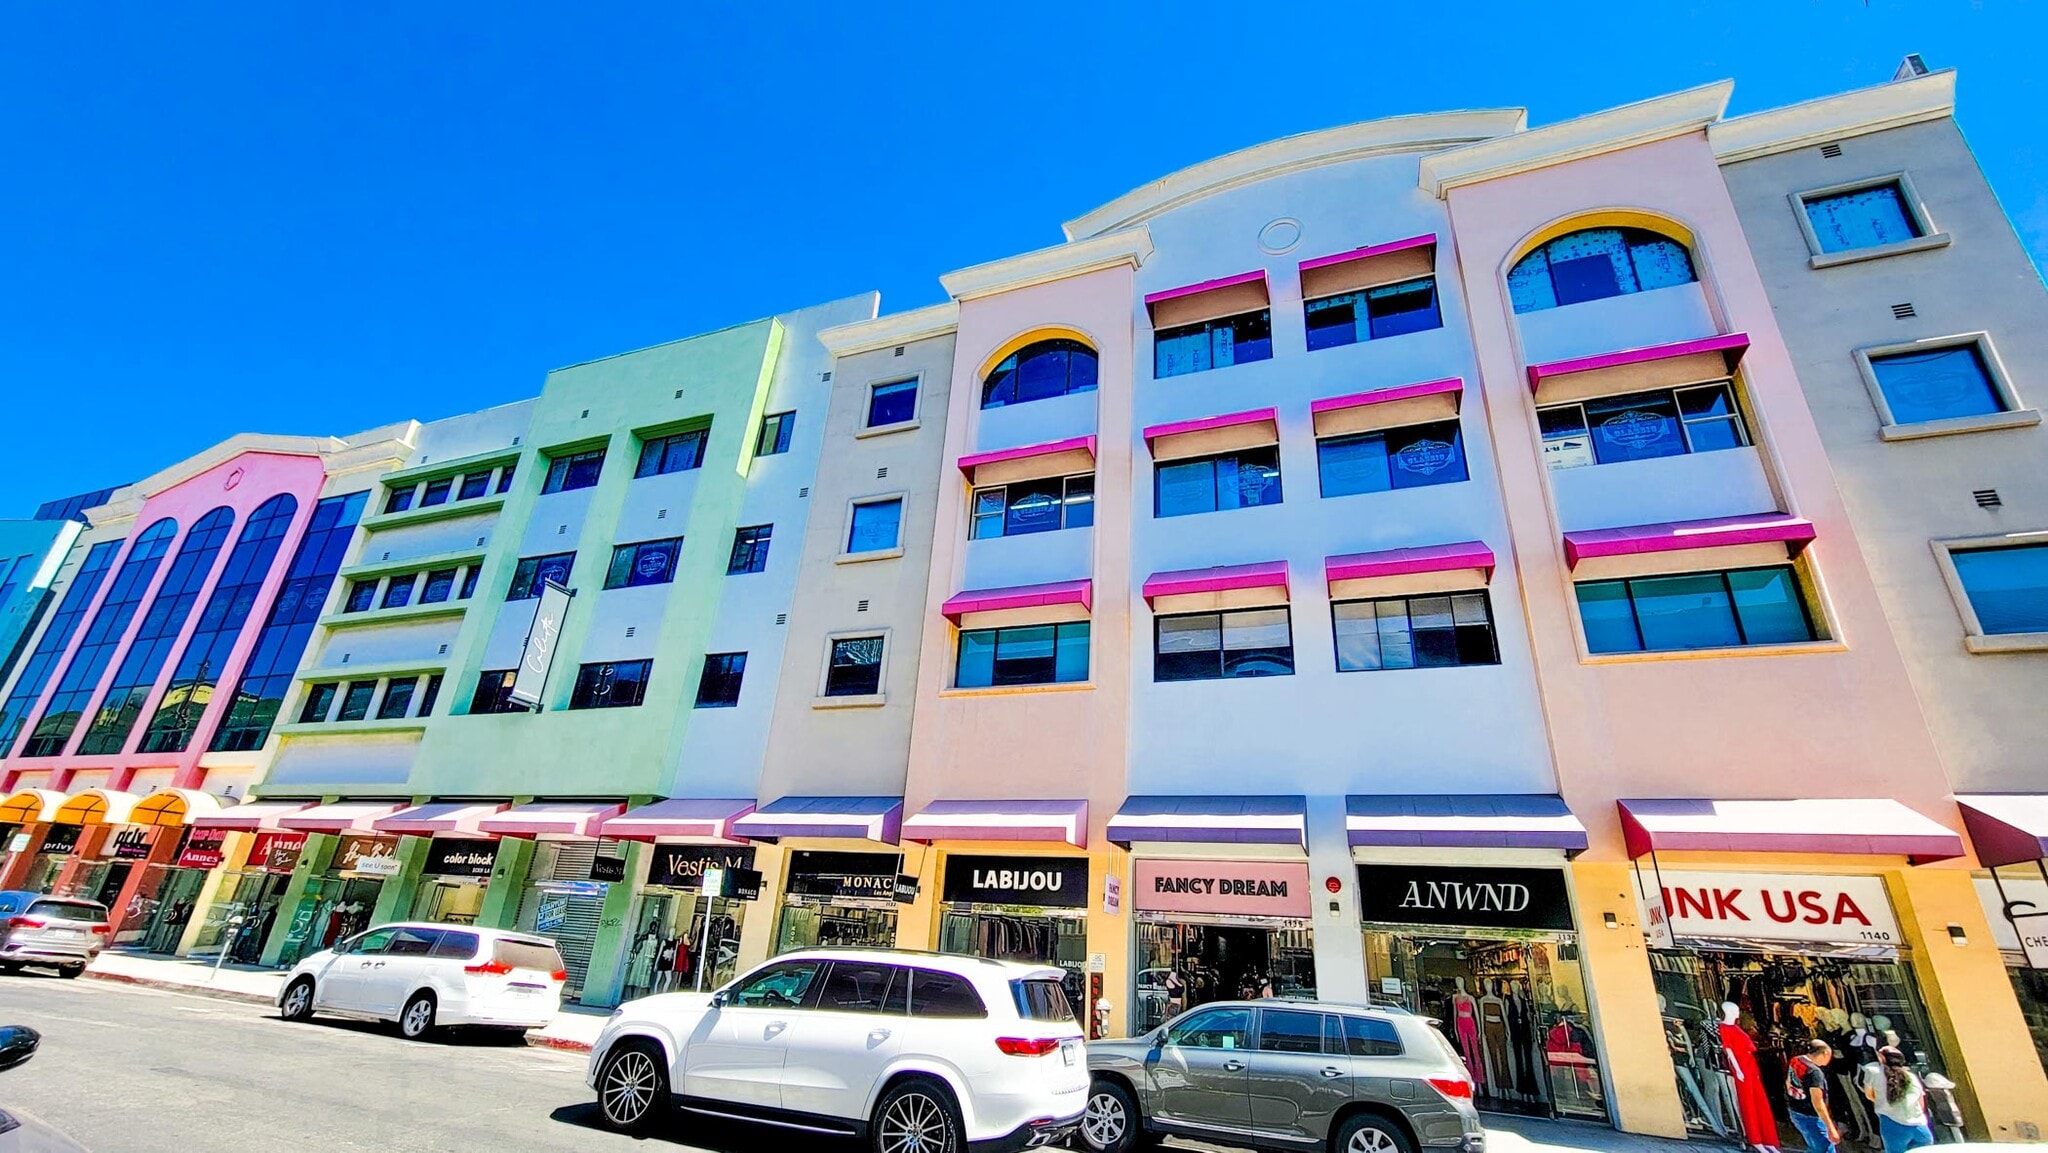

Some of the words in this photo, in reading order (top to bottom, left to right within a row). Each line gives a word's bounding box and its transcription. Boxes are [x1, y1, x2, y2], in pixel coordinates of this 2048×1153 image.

[43, 842, 74, 852] privy
[112, 828, 149, 848] priv
[258, 836, 302, 855] Anne
[182, 852, 218, 863] Annes
[443, 852, 468, 865] color
[467, 852, 494, 865] block
[842, 876, 893, 889] MONAC
[973, 869, 1062, 891] LABIJOU
[1155, 877, 1215, 895] FANCY
[1219, 879, 1288, 897] DREAM
[1399, 880, 1530, 912] ANWND
[1760, 889, 1872, 927] USA
[1859, 931, 1891, 942] 1140
